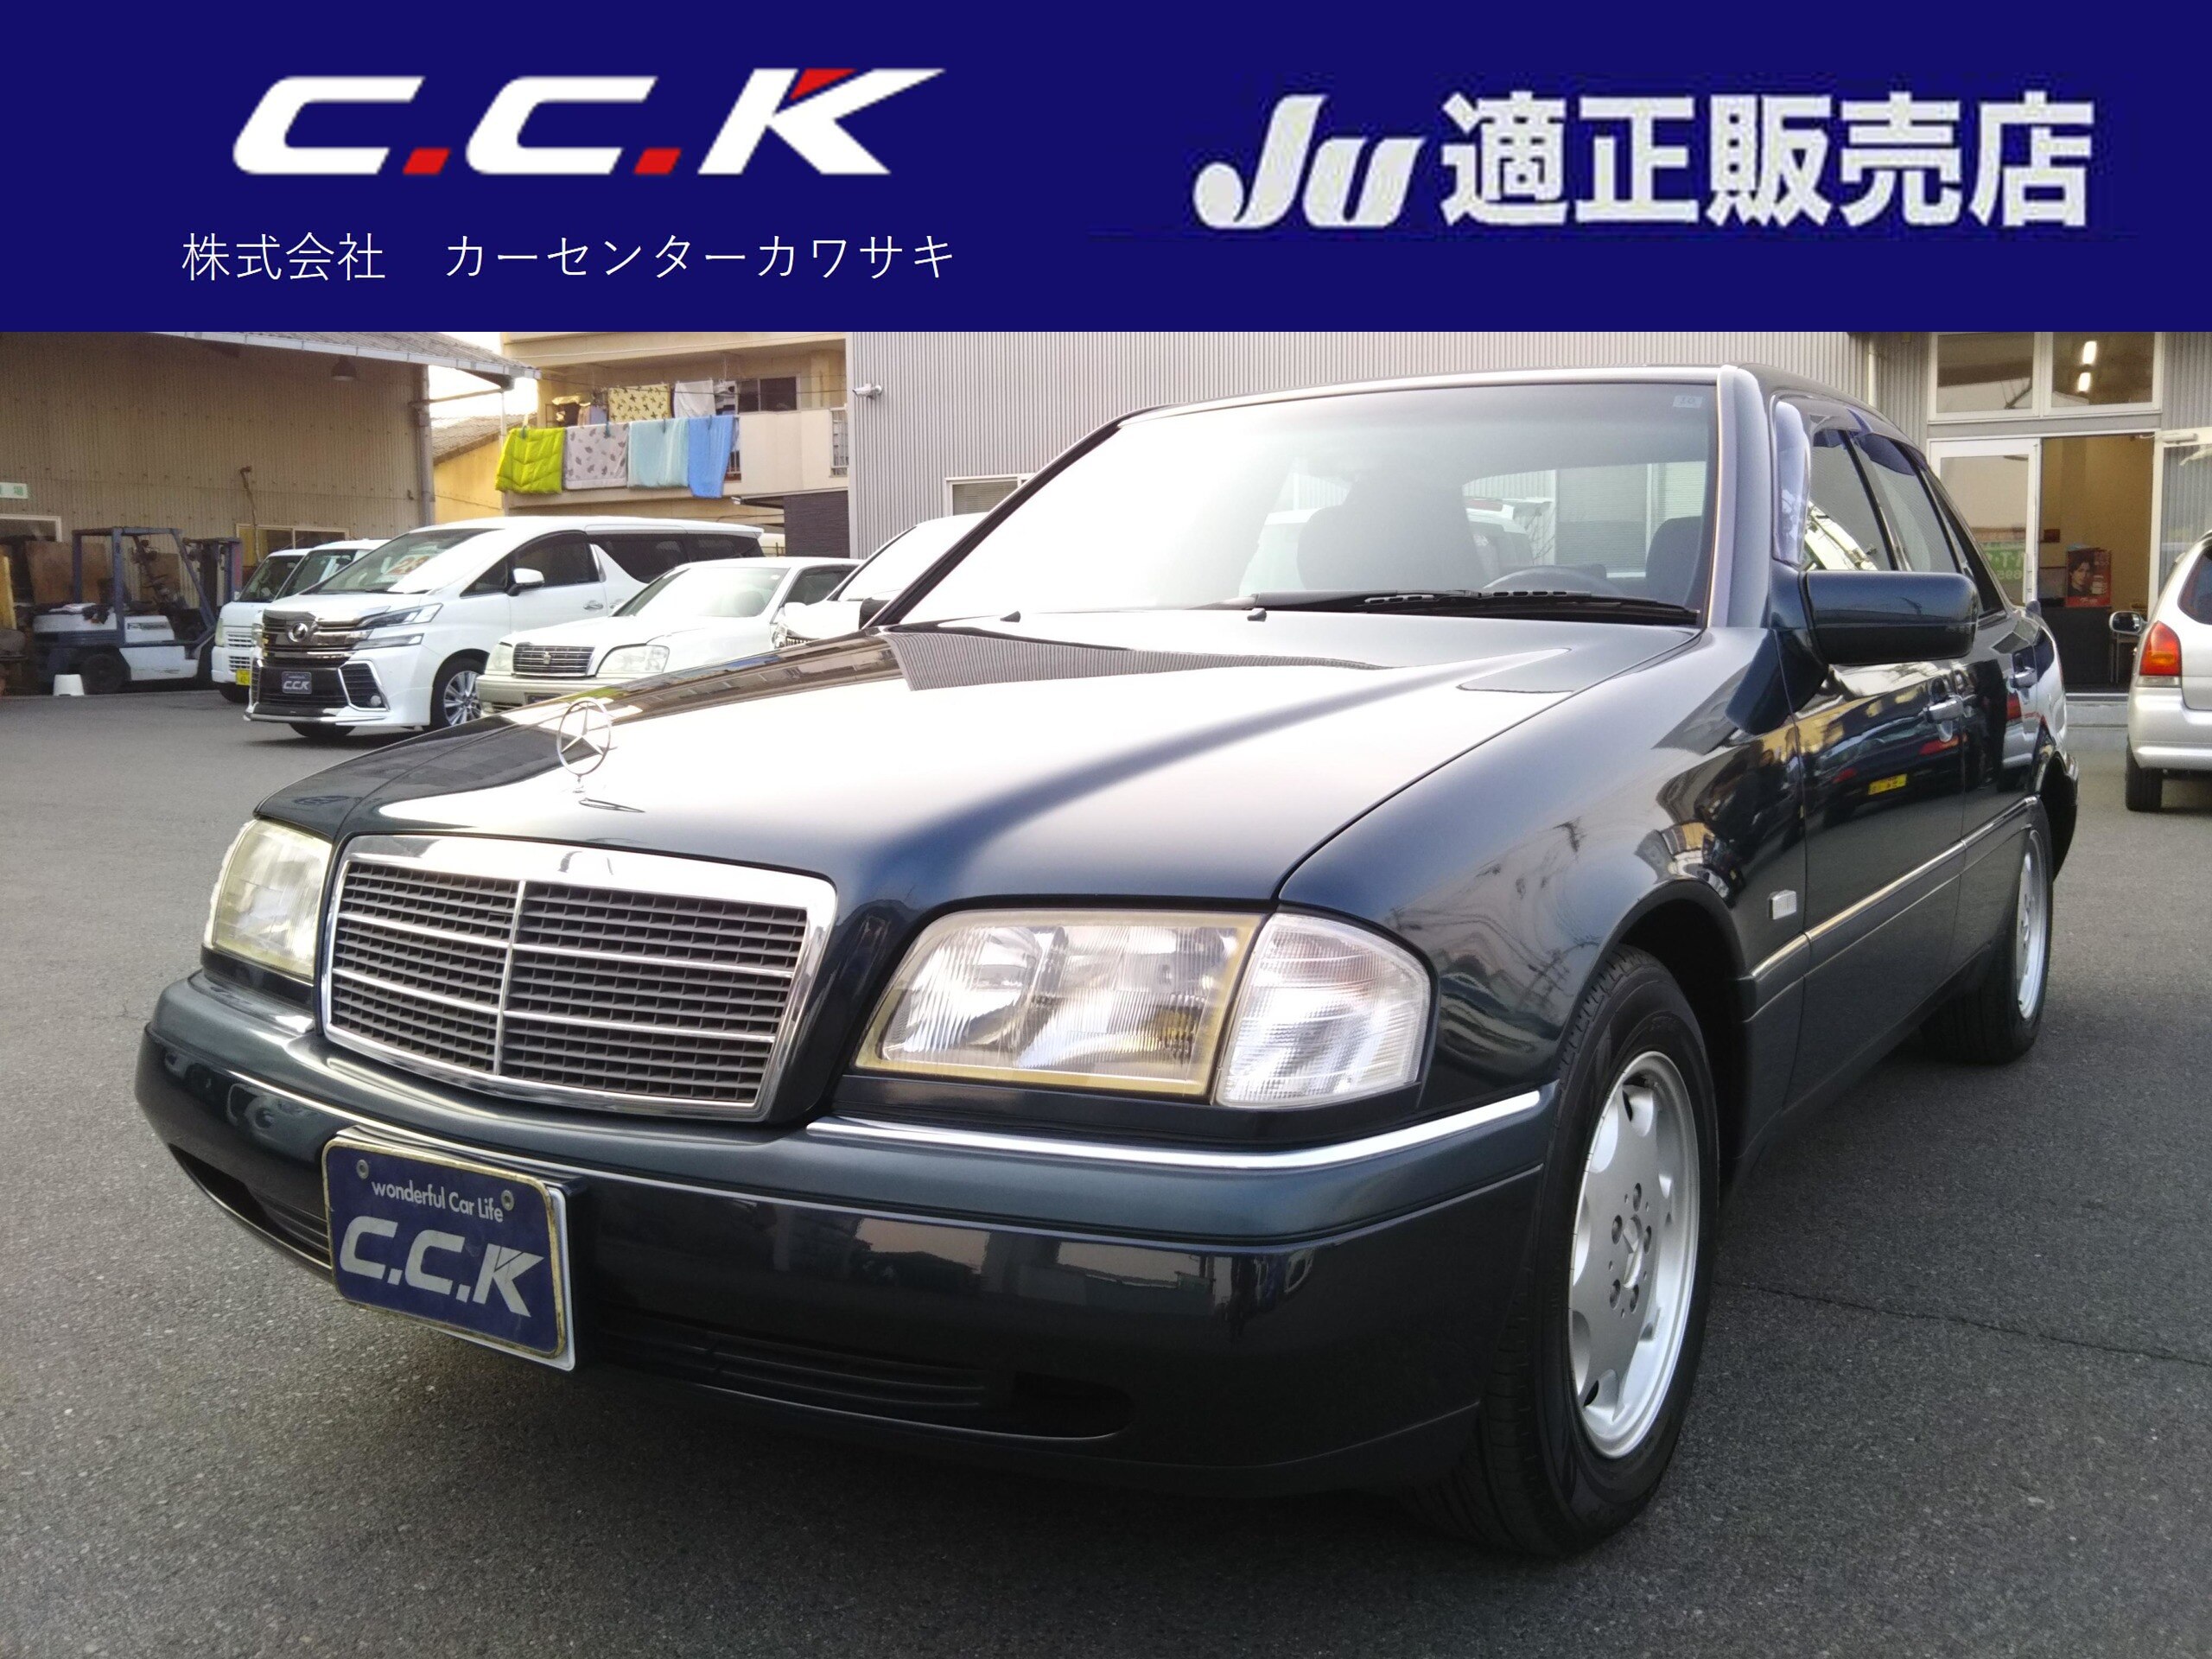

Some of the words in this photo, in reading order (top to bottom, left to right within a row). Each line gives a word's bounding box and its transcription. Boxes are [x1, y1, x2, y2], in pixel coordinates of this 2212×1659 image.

[371, 1179, 446, 1209] wonderful
[448, 1192, 475, 1215] Car
[477, 1198, 504, 1223] Life
[340, 1216, 544, 1318] C.C.K
